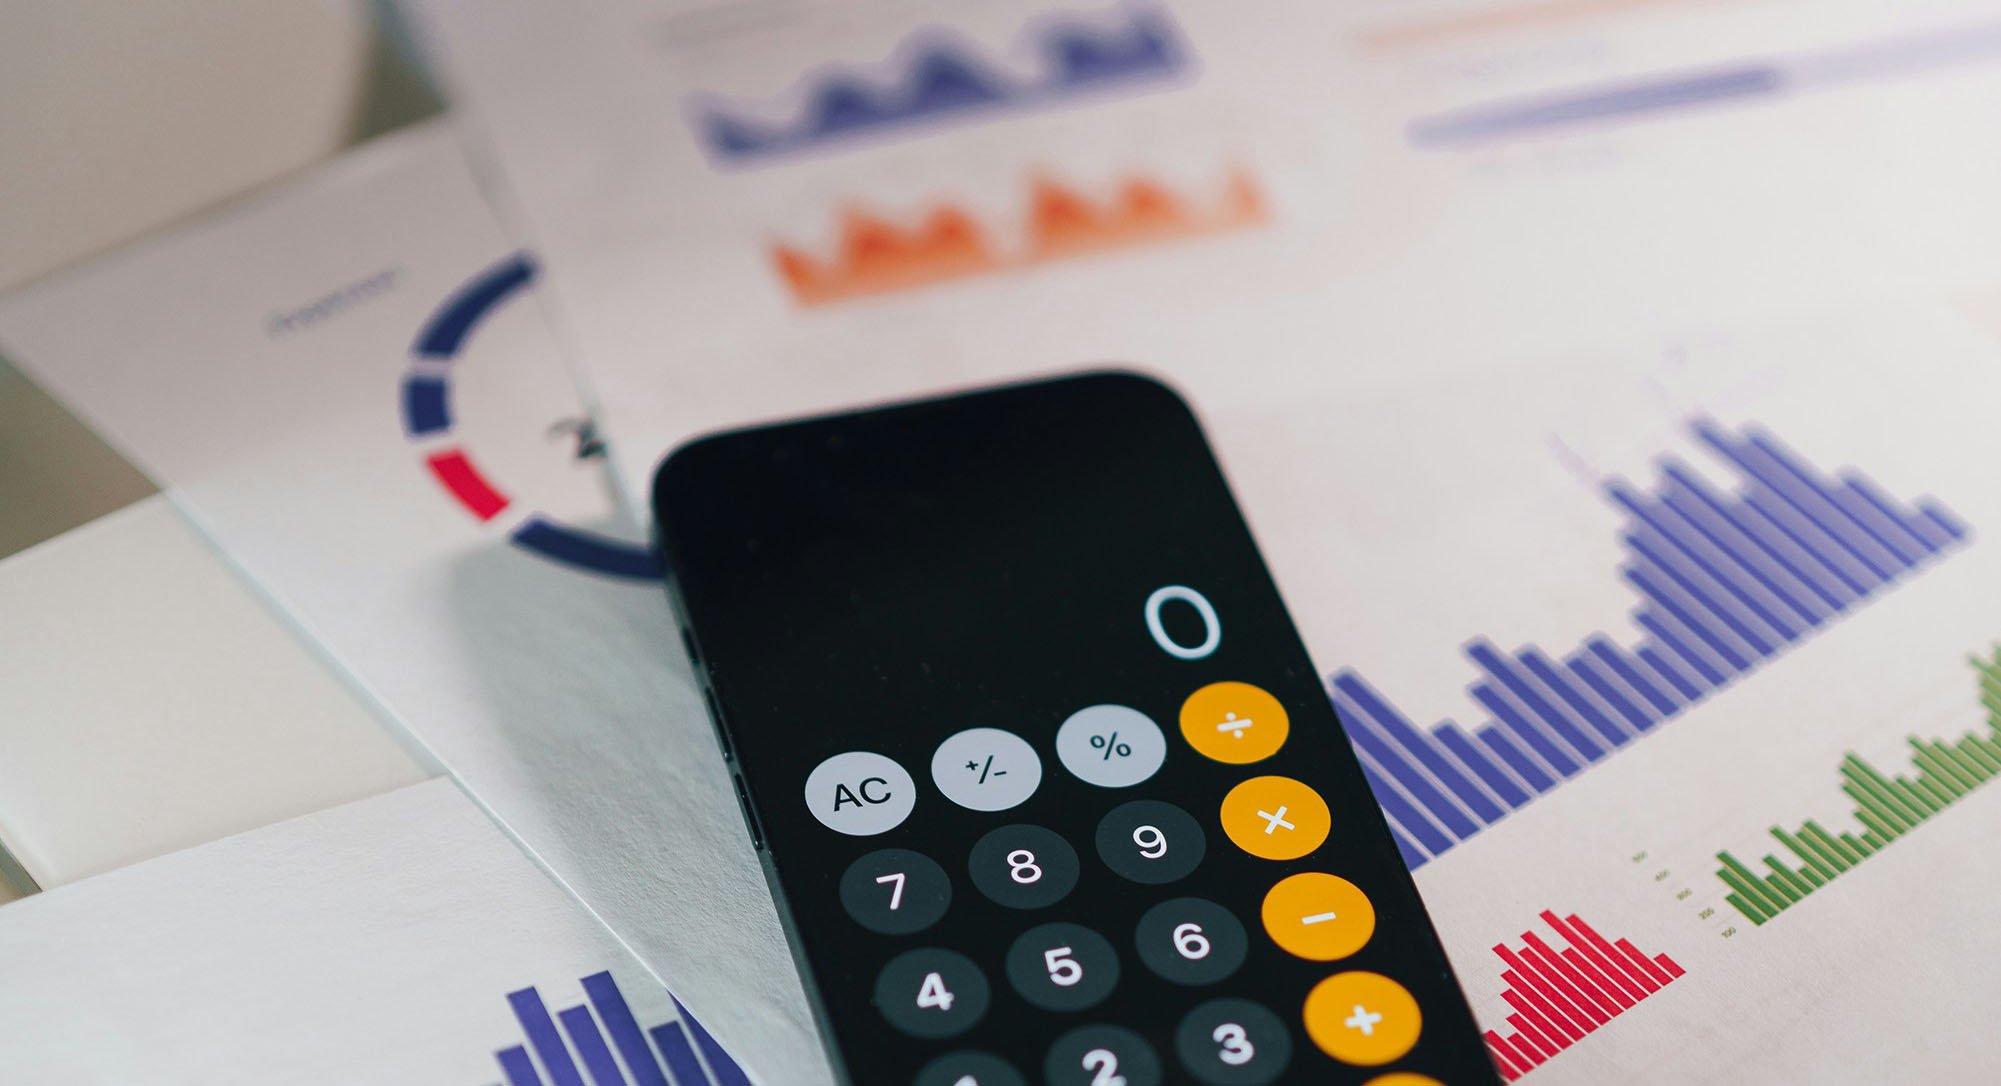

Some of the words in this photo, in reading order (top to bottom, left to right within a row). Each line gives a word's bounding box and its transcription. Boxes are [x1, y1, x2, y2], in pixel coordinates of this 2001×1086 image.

[1145, 585, 1221, 659] 0
[832, 777, 893, 812] AC
[965, 755, 1008, 785] +/-
[1089, 731, 1132, 761] %
[875, 872, 906, 910] 7
[1006, 849, 1043, 884] 8
[1132, 825, 1168, 859] 9
[916, 972, 955, 1011] 4
[1044, 946, 1083, 986] 5
[1172, 922, 1211, 960] 6
[1082, 1049, 1128, 1086] 2
[1213, 1023, 1255, 1065] 3
